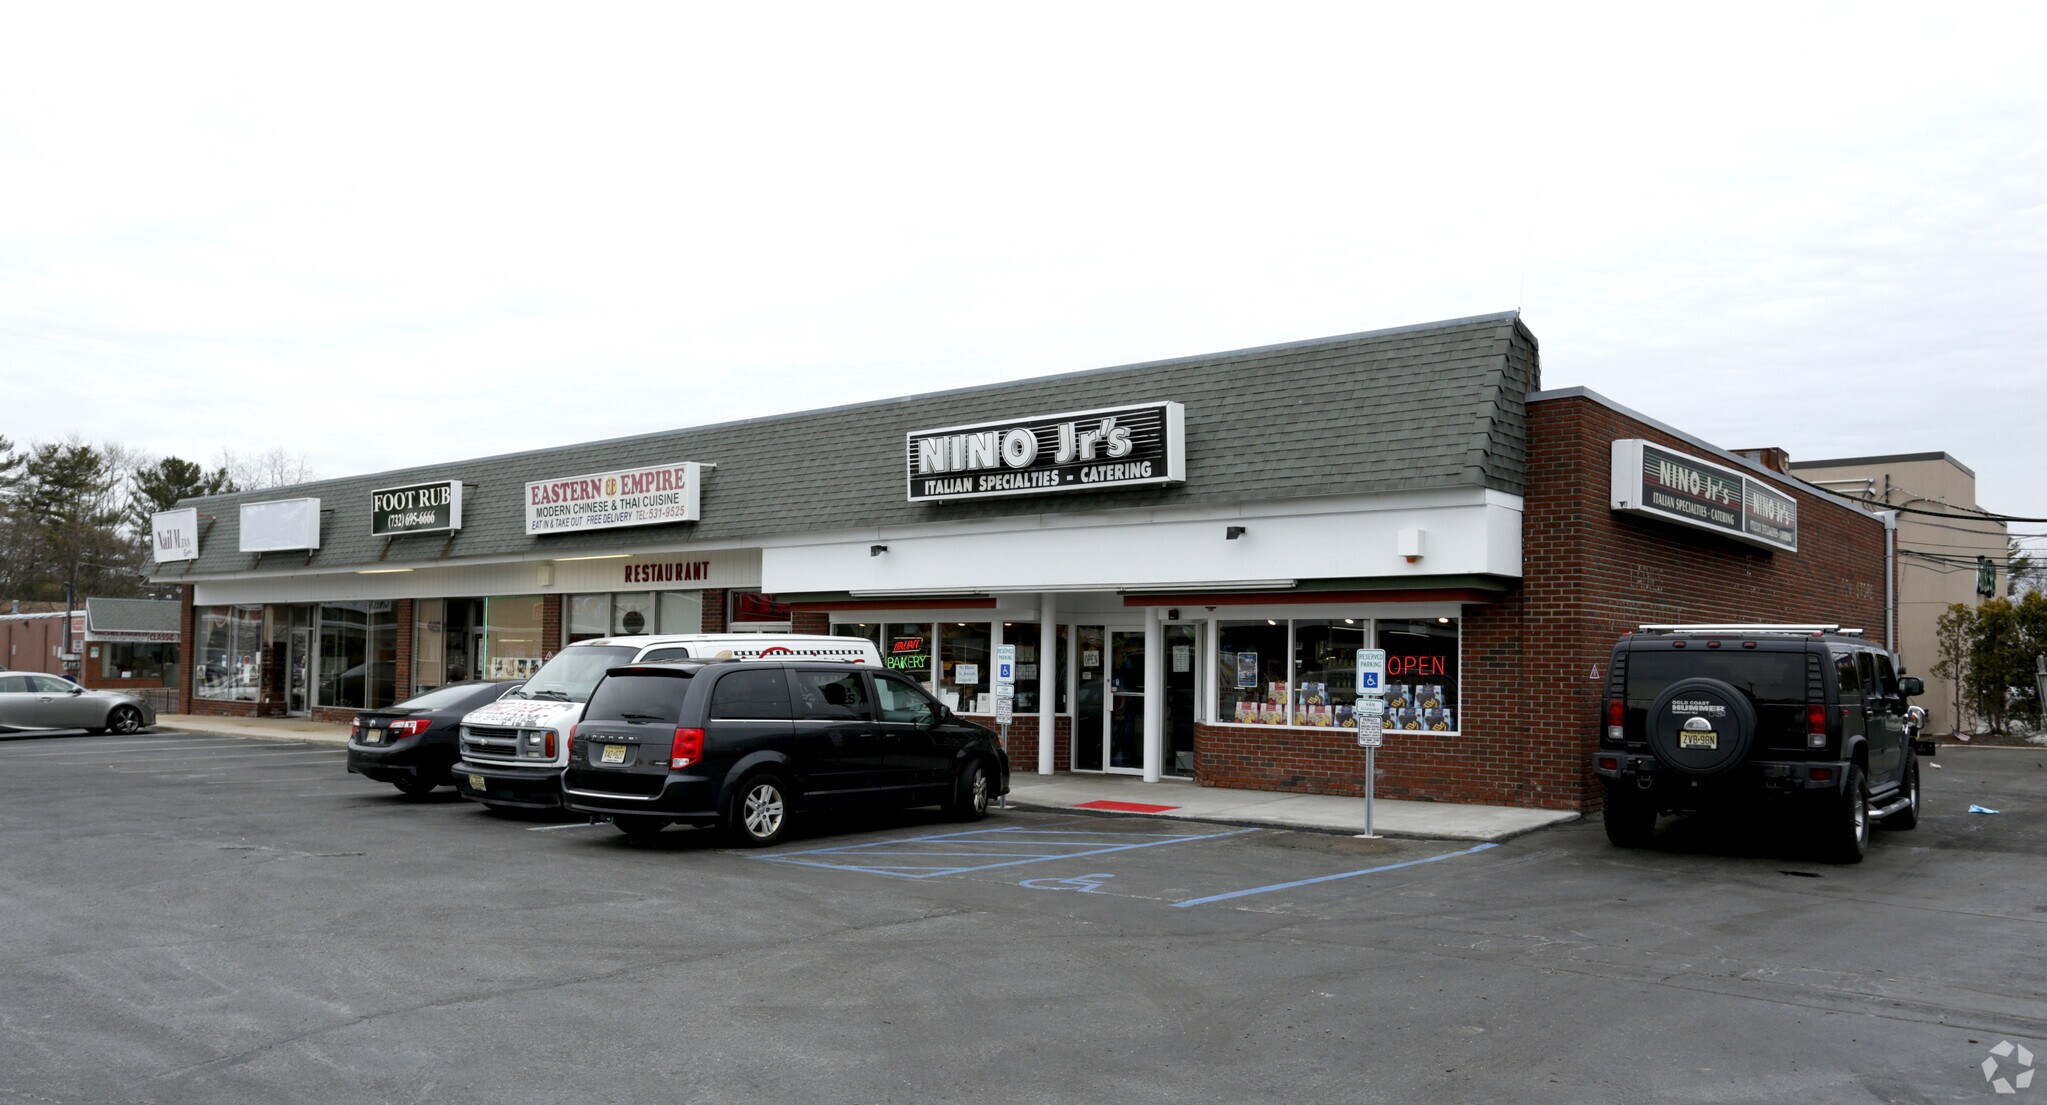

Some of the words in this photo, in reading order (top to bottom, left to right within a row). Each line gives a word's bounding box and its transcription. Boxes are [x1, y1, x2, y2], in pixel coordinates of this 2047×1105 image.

[919, 428, 1038, 475] NINO
[1055, 417, 1132, 464] Jr's
[531, 478, 602, 506] EASTERN
[620, 468, 685, 495] EMPIRE
[924, 477, 973, 496] ITALIAN
[979, 470, 1059, 492] SPECIALTIES
[1080, 461, 1152, 484] CATERING
[1660, 460, 1700, 496] NINO
[1705, 476, 1729, 504] Jr's
[373, 491, 416, 512] FOOT
[419, 486, 451, 508] RUB
[536, 503, 570, 518] MODERN
[573, 499, 608, 514] CHINESE
[611, 499, 617, 511] &
[620, 496, 641, 509] THAI
[644, 492, 679, 508] CUISINE
[1653, 492, 1674, 510] ITALIAN
[1676, 498, 1707, 518] SPECIALTIES
[1711, 509, 1734, 526] CATERING
[1754, 493, 1774, 520] NINO
[1777, 502, 1789, 525] Jr's
[388, 512, 405, 529] (732)
[405, 510, 435, 527] 695-6666
[532, 519, 543, 530] EAT
[544, 518, 549, 529] IN
[550, 518, 555, 528] &
[556, 516, 569, 528] TAKE
[570, 516, 582, 527] OUT
[587, 514, 602, 525] FREE
[602, 511, 632, 524] DELIVERY
[158, 529, 172, 550] Nail
[625, 561, 709, 583] RESTAURANT
[150, 633, 174, 641] CLASSIC
[888, 655, 927, 669] BAKERY
[1085, 654, 1098, 664] OPEN
[1388, 656, 1445, 676] OPEN
